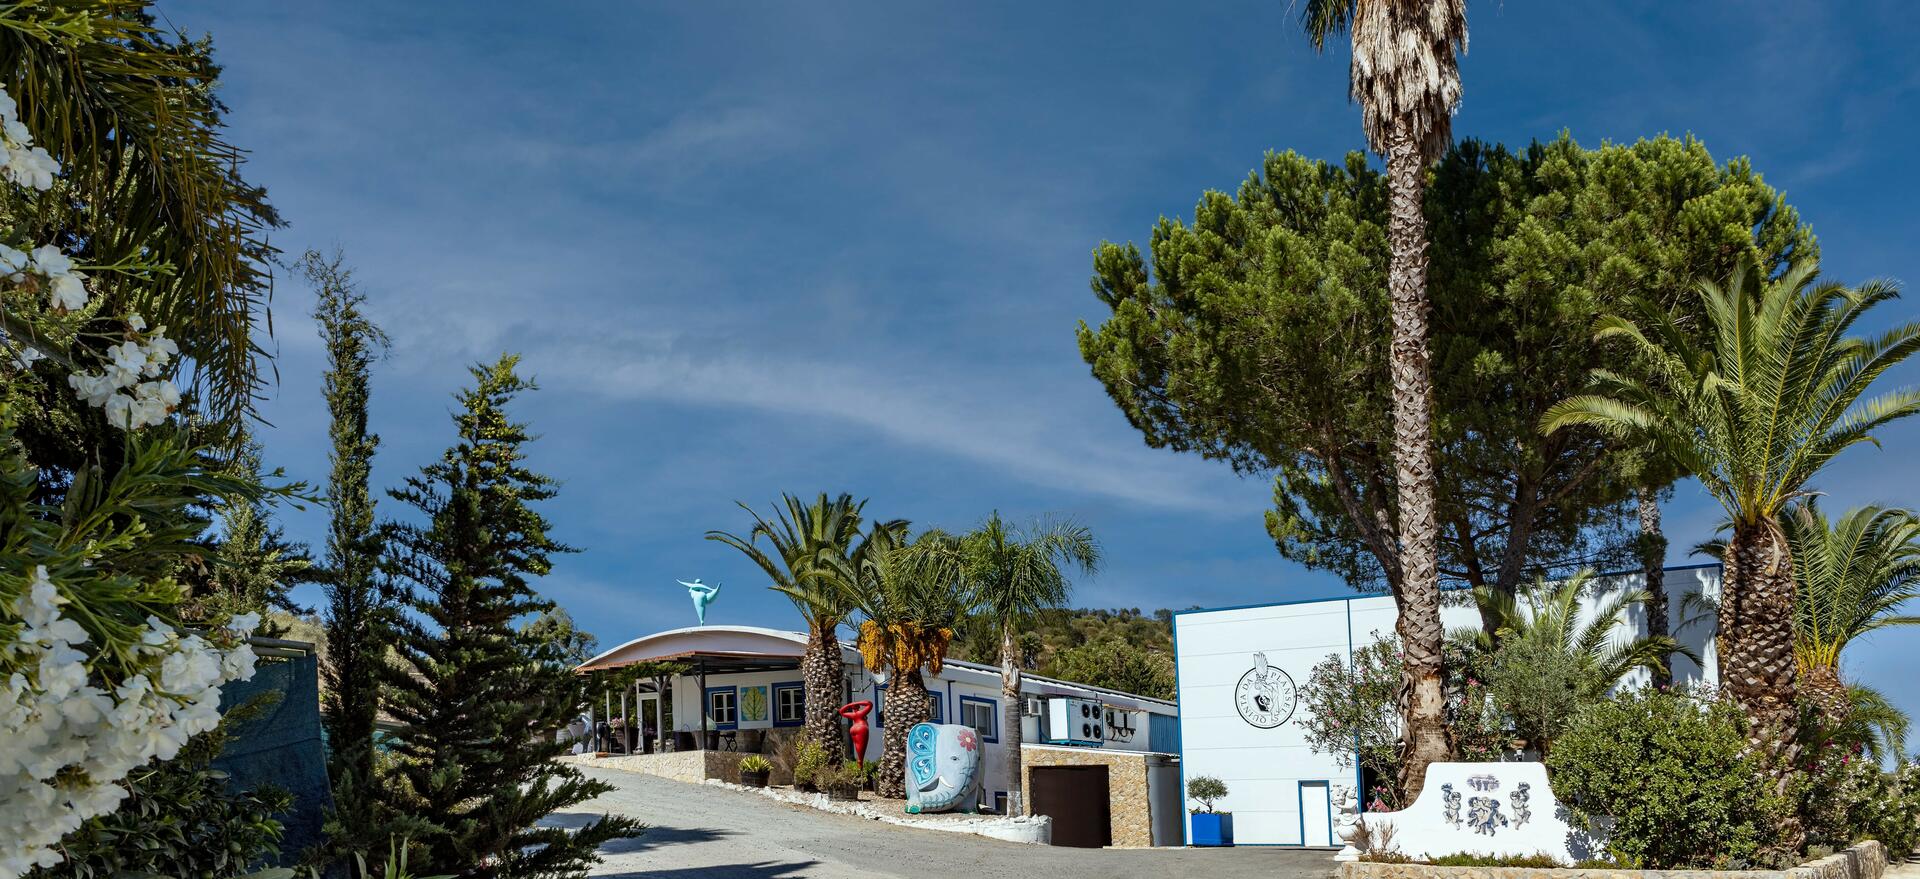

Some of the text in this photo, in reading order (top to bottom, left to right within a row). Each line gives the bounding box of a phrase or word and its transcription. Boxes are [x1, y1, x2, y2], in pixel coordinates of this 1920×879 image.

[1240, 672, 1291, 723] QUINTA DA PLANSEL
